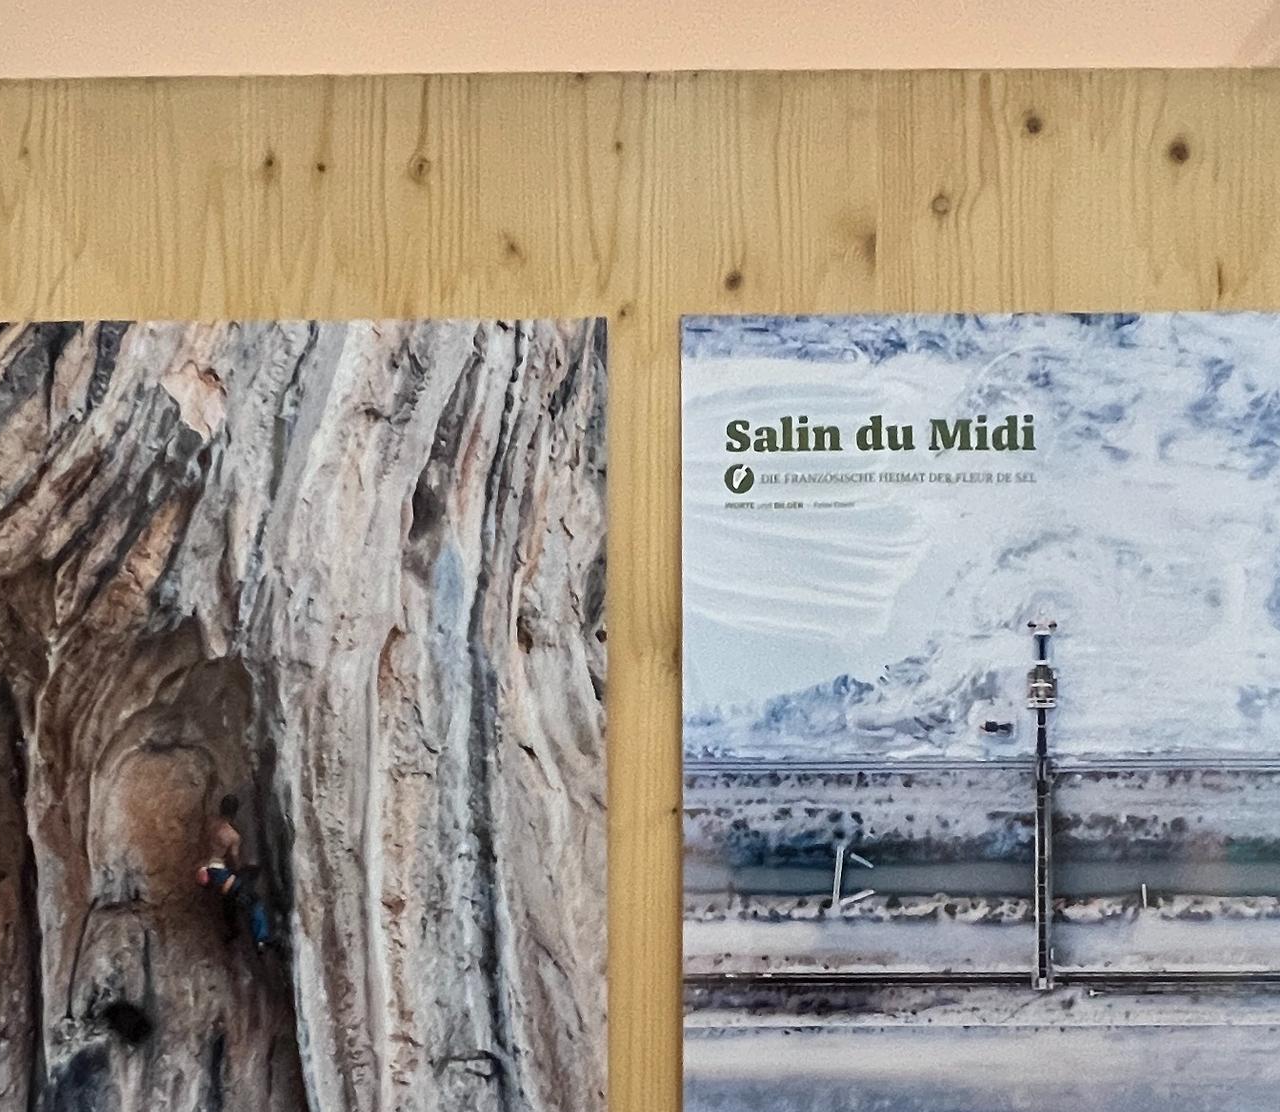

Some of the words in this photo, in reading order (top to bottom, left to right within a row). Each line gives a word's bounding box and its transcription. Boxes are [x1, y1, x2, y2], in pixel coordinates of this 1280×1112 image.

[725, 415, 843, 452] Salin
[856, 415, 916, 451] du
[928, 414, 1037, 451] Midi
[760, 472, 781, 485] DIE
[879, 471, 926, 483] HEIMAT
[929, 471, 952, 484] DER
[955, 471, 993, 484] FLEUR
[996, 471, 1012, 483] DE
[1015, 472, 1038, 484] SEL
